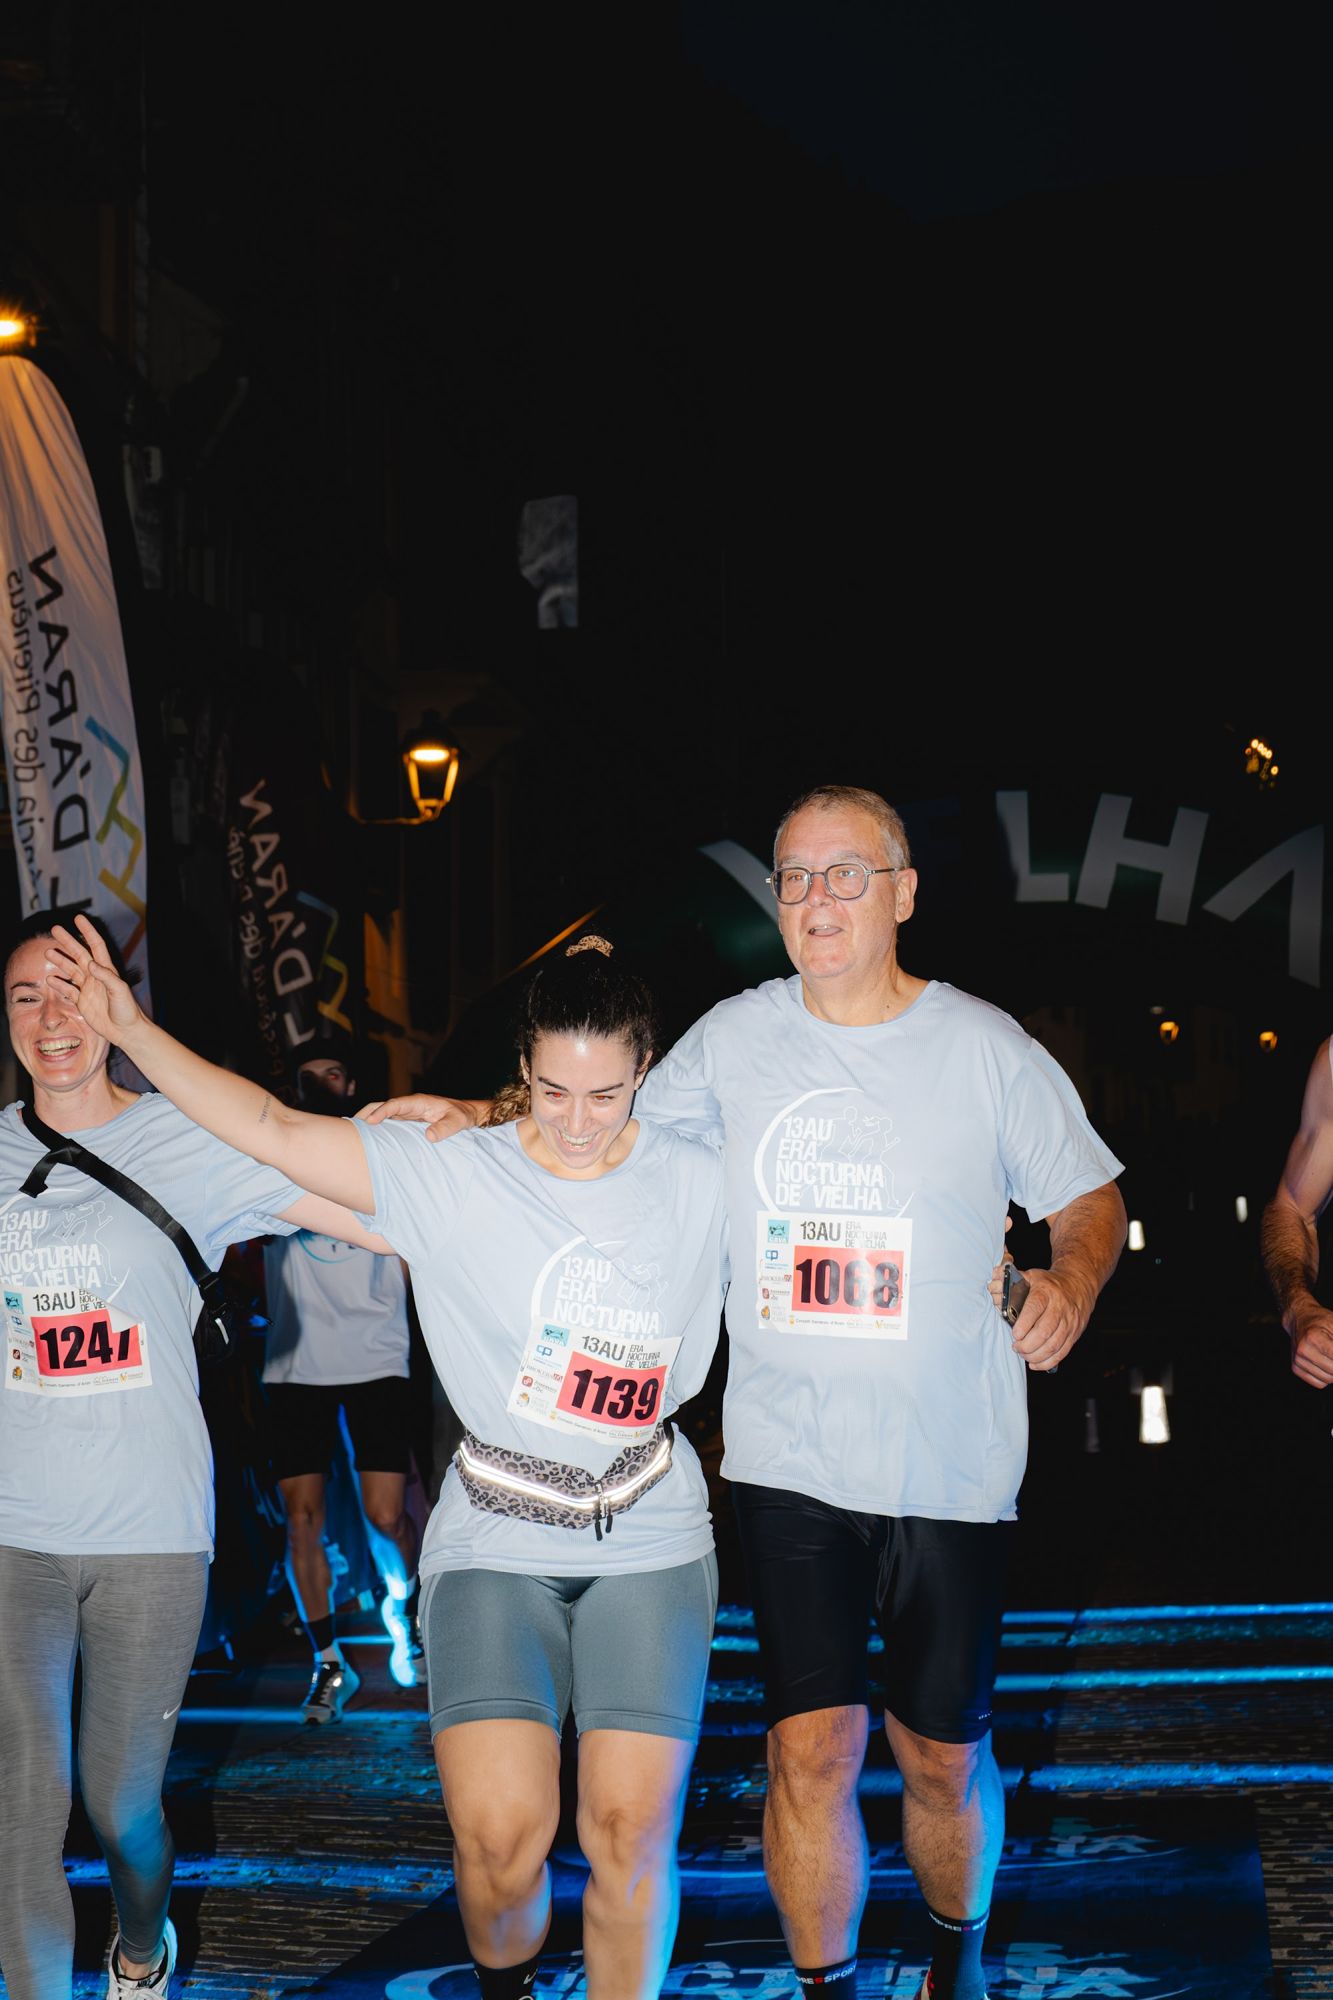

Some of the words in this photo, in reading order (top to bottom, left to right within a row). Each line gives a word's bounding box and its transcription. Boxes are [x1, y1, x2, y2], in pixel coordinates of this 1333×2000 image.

[783, 1115, 834, 1142] 13AU
[776, 1138, 818, 1161] ERA
[775, 1160, 884, 1188] NOCTURNA
[775, 1183, 802, 1206] DE
[812, 1185, 883, 1211] VIELHA
[0, 1209, 48, 1232] 13AU
[801, 1221, 841, 1241] 13AU
[846, 1221, 862, 1230] ERA
[0, 1231, 33, 1252] ERA
[845, 1239, 855, 1248] DE
[861, 1240, 886, 1249] IELHA
[0, 1244, 101, 1275] NOCTURNA
[562, 1256, 613, 1283] 13AU
[33, 1266, 101, 1288] VIELHA
[796, 1258, 900, 1309] 1068
[33, 1291, 76, 1312] 13AU
[557, 1276, 598, 1305] ERA
[553, 1299, 660, 1335] NOCTURNA
[582, 1336, 626, 1361] 13AU
[627, 1352, 661, 1361] NOCTURNA
[630, 1345, 645, 1353] ERA
[625, 1360, 636, 1368] DE
[639, 1360, 659, 1369] VIELHA
[571, 1368, 660, 1421] 1139
